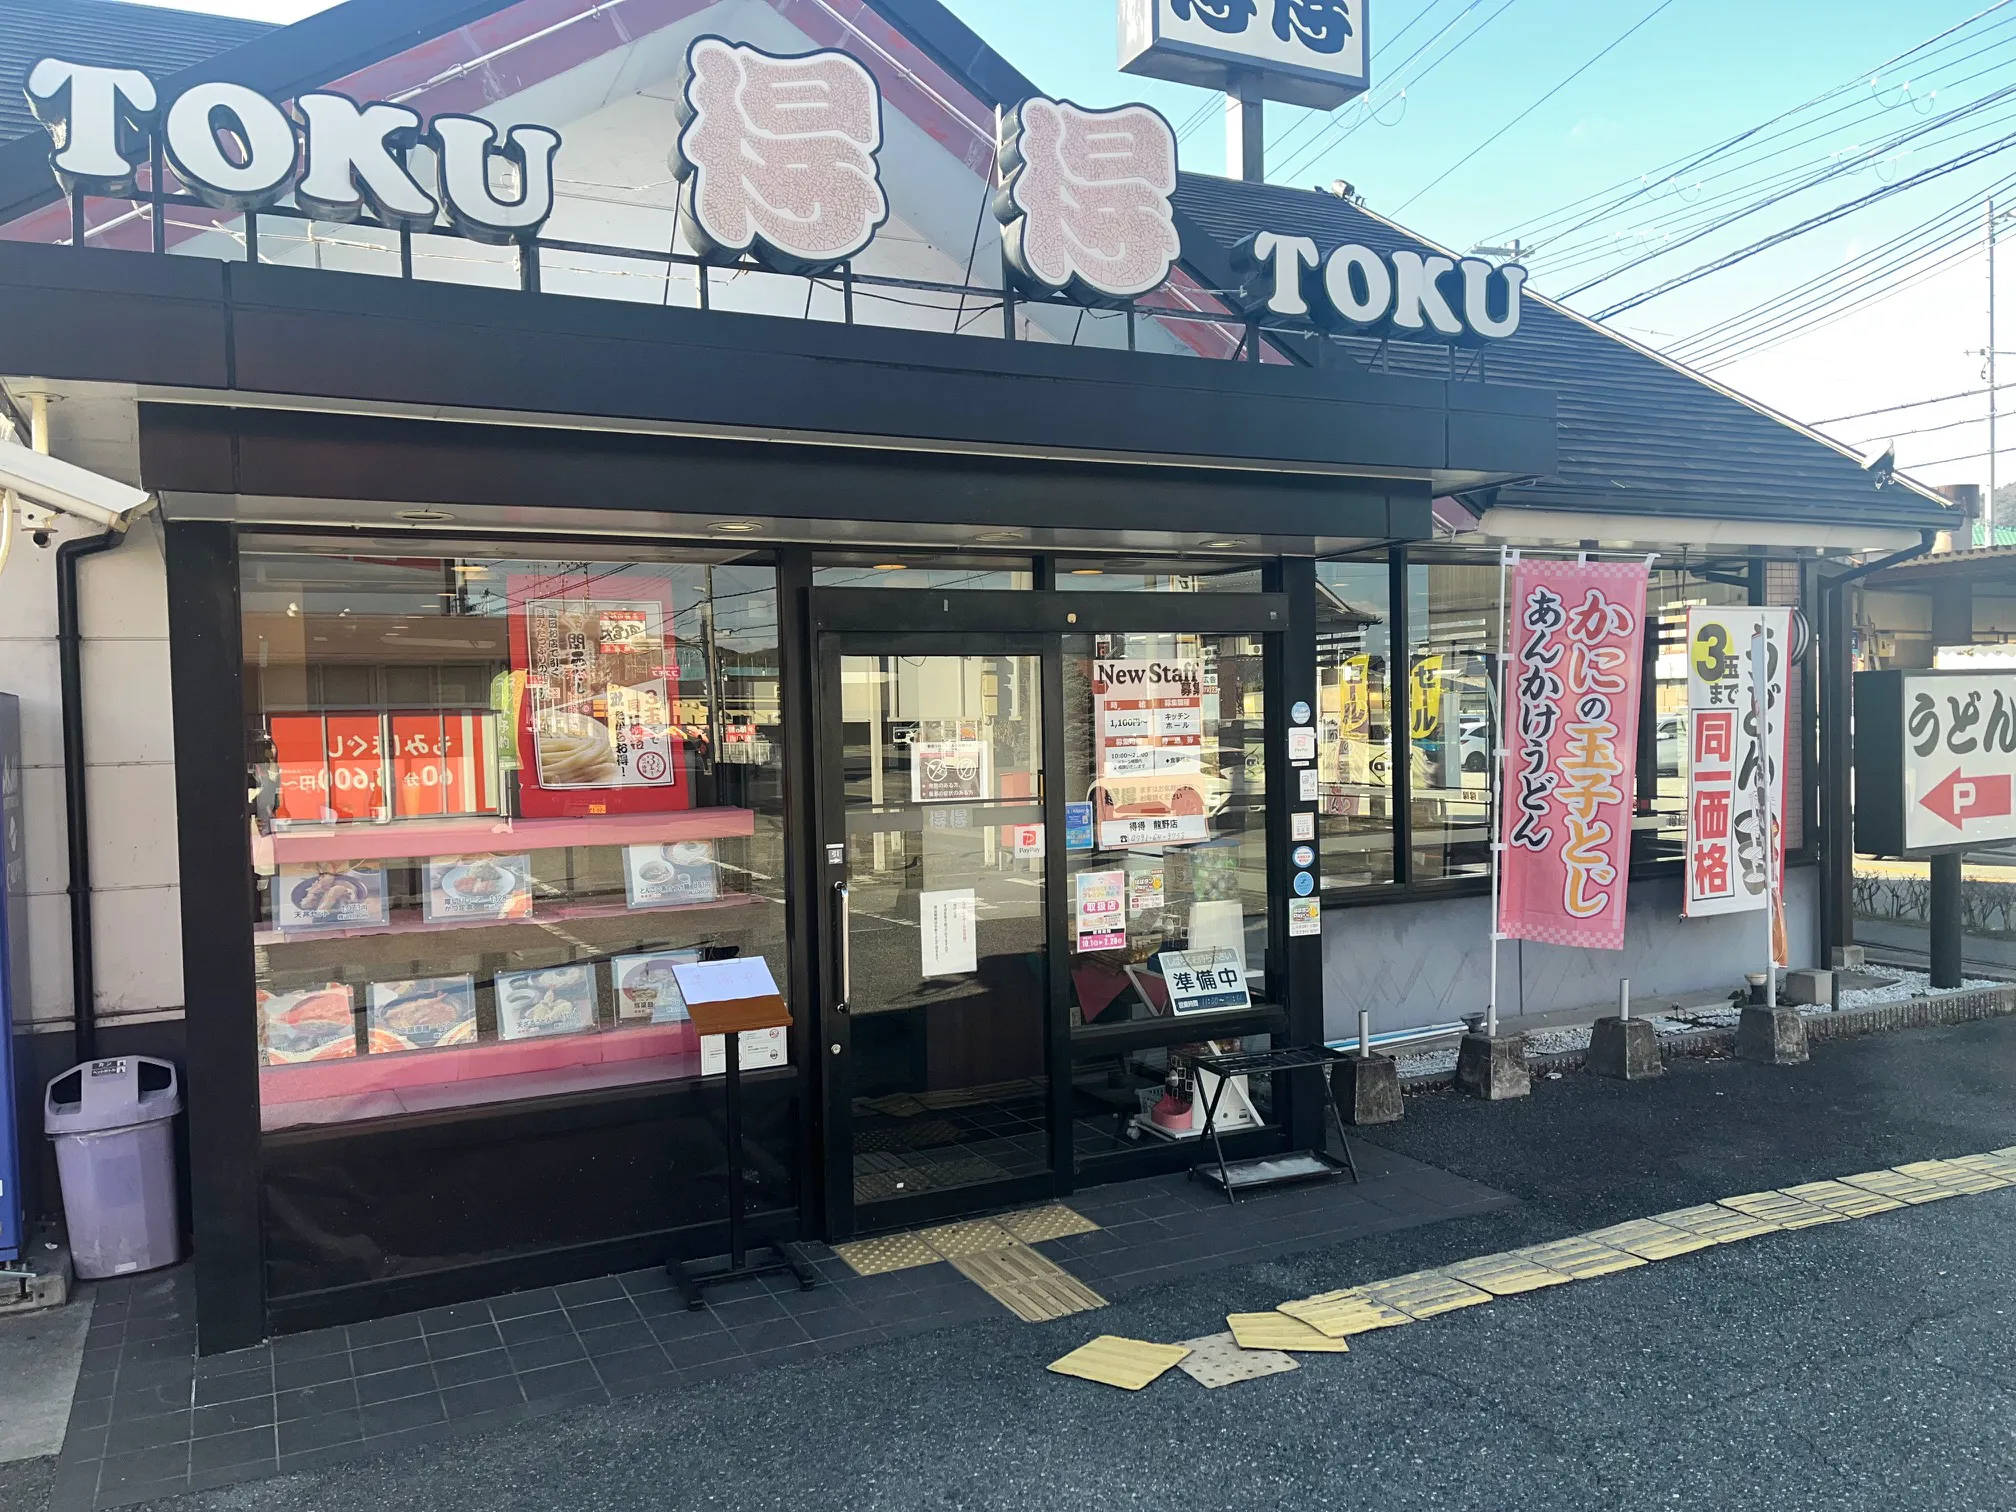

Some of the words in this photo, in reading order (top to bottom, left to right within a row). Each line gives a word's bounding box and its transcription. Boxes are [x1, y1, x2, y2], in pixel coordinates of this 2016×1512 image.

[26, 56, 560, 234] TOKU
[1254, 230, 1528, 340] TOKU
[1098, 664, 1146, 684] New
[1149, 662, 1200, 684] Staff
[1696, 623, 1740, 681] 3玉
[1164, 712, 1190, 720] キッチン
[1411, 665, 1437, 733] セール
[1513, 590, 1564, 849] あんかけうどん
[1709, 683, 1740, 705] まで
[1908, 688, 2016, 758] うどん
[1556, 592, 1630, 915] かにの玉子とじ
[1693, 711, 1733, 896] 同一価格
[1952, 782, 1976, 815] P
[1086, 900, 1116, 912] 取扱店
[1173, 967, 1238, 992] 準備中
